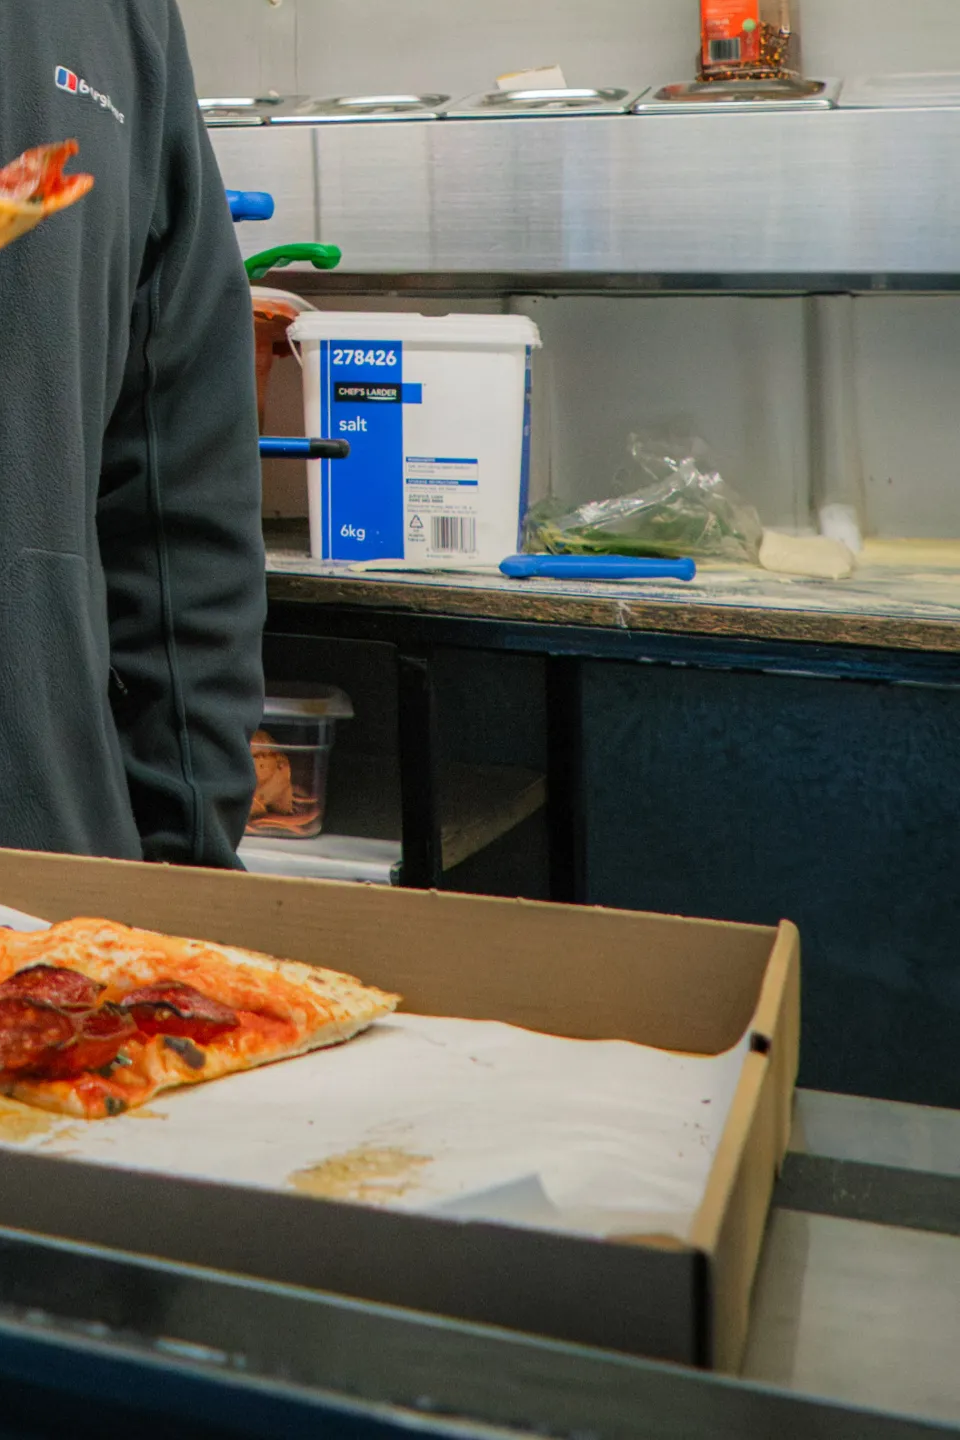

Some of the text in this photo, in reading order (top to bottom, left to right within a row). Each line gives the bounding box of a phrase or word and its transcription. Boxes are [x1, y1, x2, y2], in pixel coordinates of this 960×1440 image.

[332, 349, 397, 366] 278426
[338, 387, 397, 397] CHEF'S LARDER
[339, 416, 367, 432] salt
[340, 524, 365, 540] 6kg
